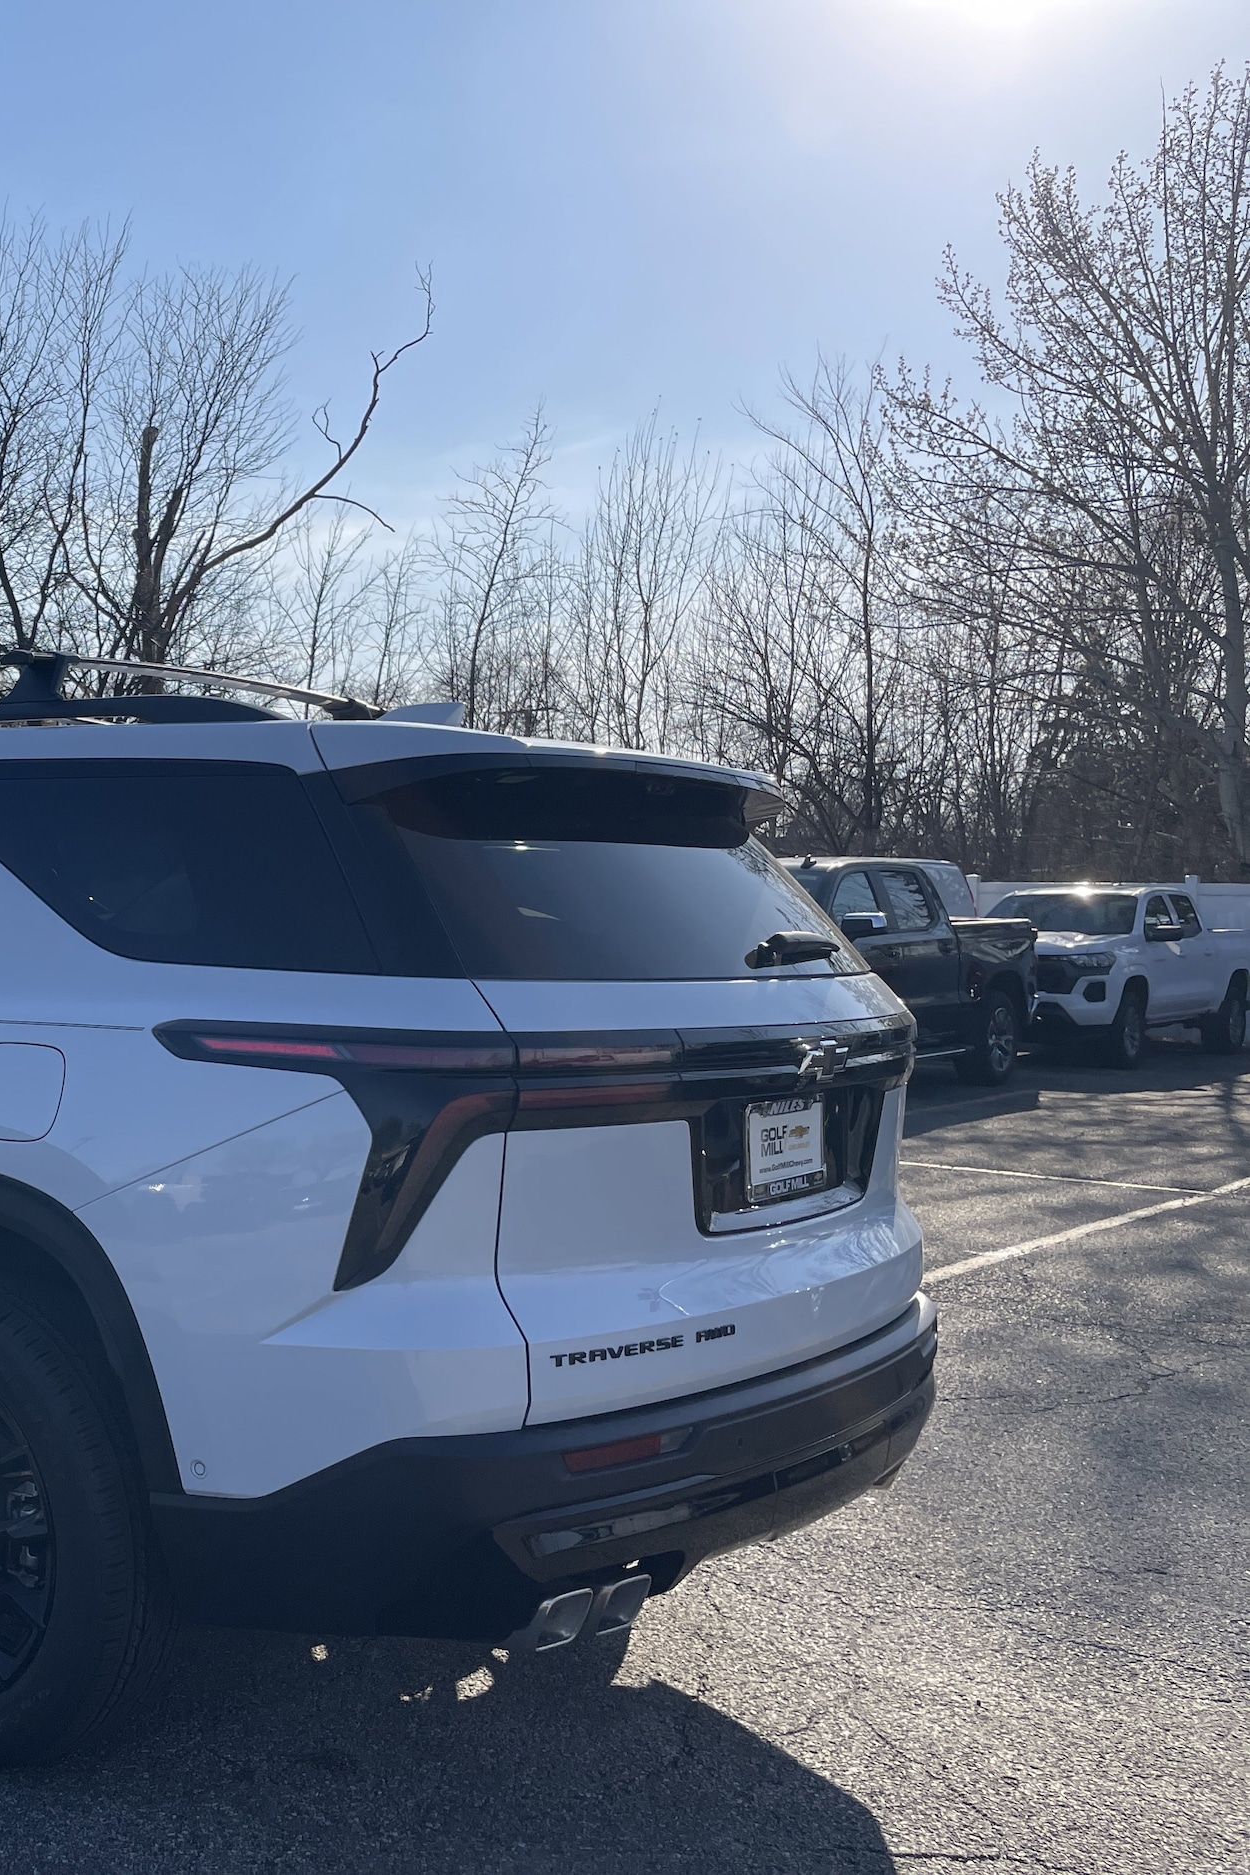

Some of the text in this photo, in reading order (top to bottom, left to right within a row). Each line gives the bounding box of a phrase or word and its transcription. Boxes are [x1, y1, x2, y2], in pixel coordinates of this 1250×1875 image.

[770, 1099, 805, 1115] NILES
[761, 1125, 787, 1142] GOLF
[761, 1140, 783, 1157] MILL
[770, 1175, 810, 1196] GOLF MILL
[549, 1335, 684, 1368] TRAVERSE
